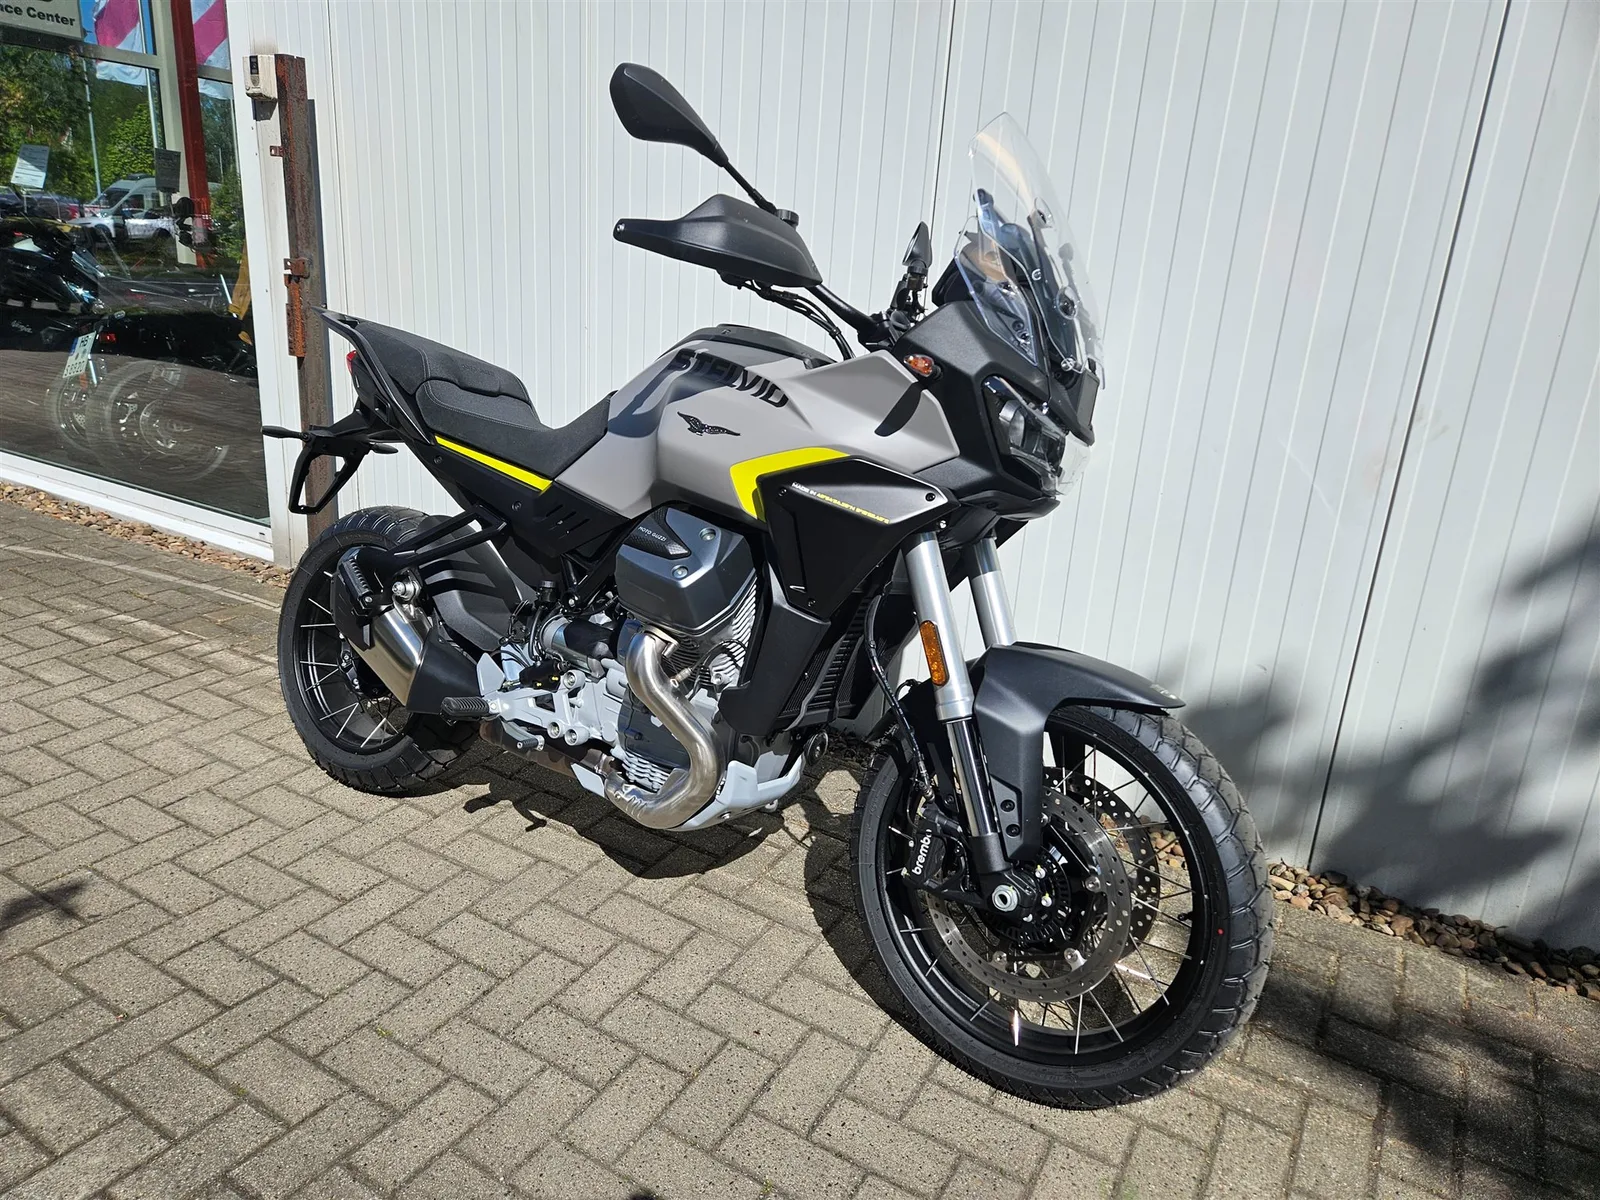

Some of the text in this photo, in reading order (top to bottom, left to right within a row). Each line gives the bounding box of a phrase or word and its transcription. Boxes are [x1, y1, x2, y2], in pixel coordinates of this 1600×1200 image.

[26, 6, 76, 26] Center
[638, 526, 667, 542] MOTO GUZZI
